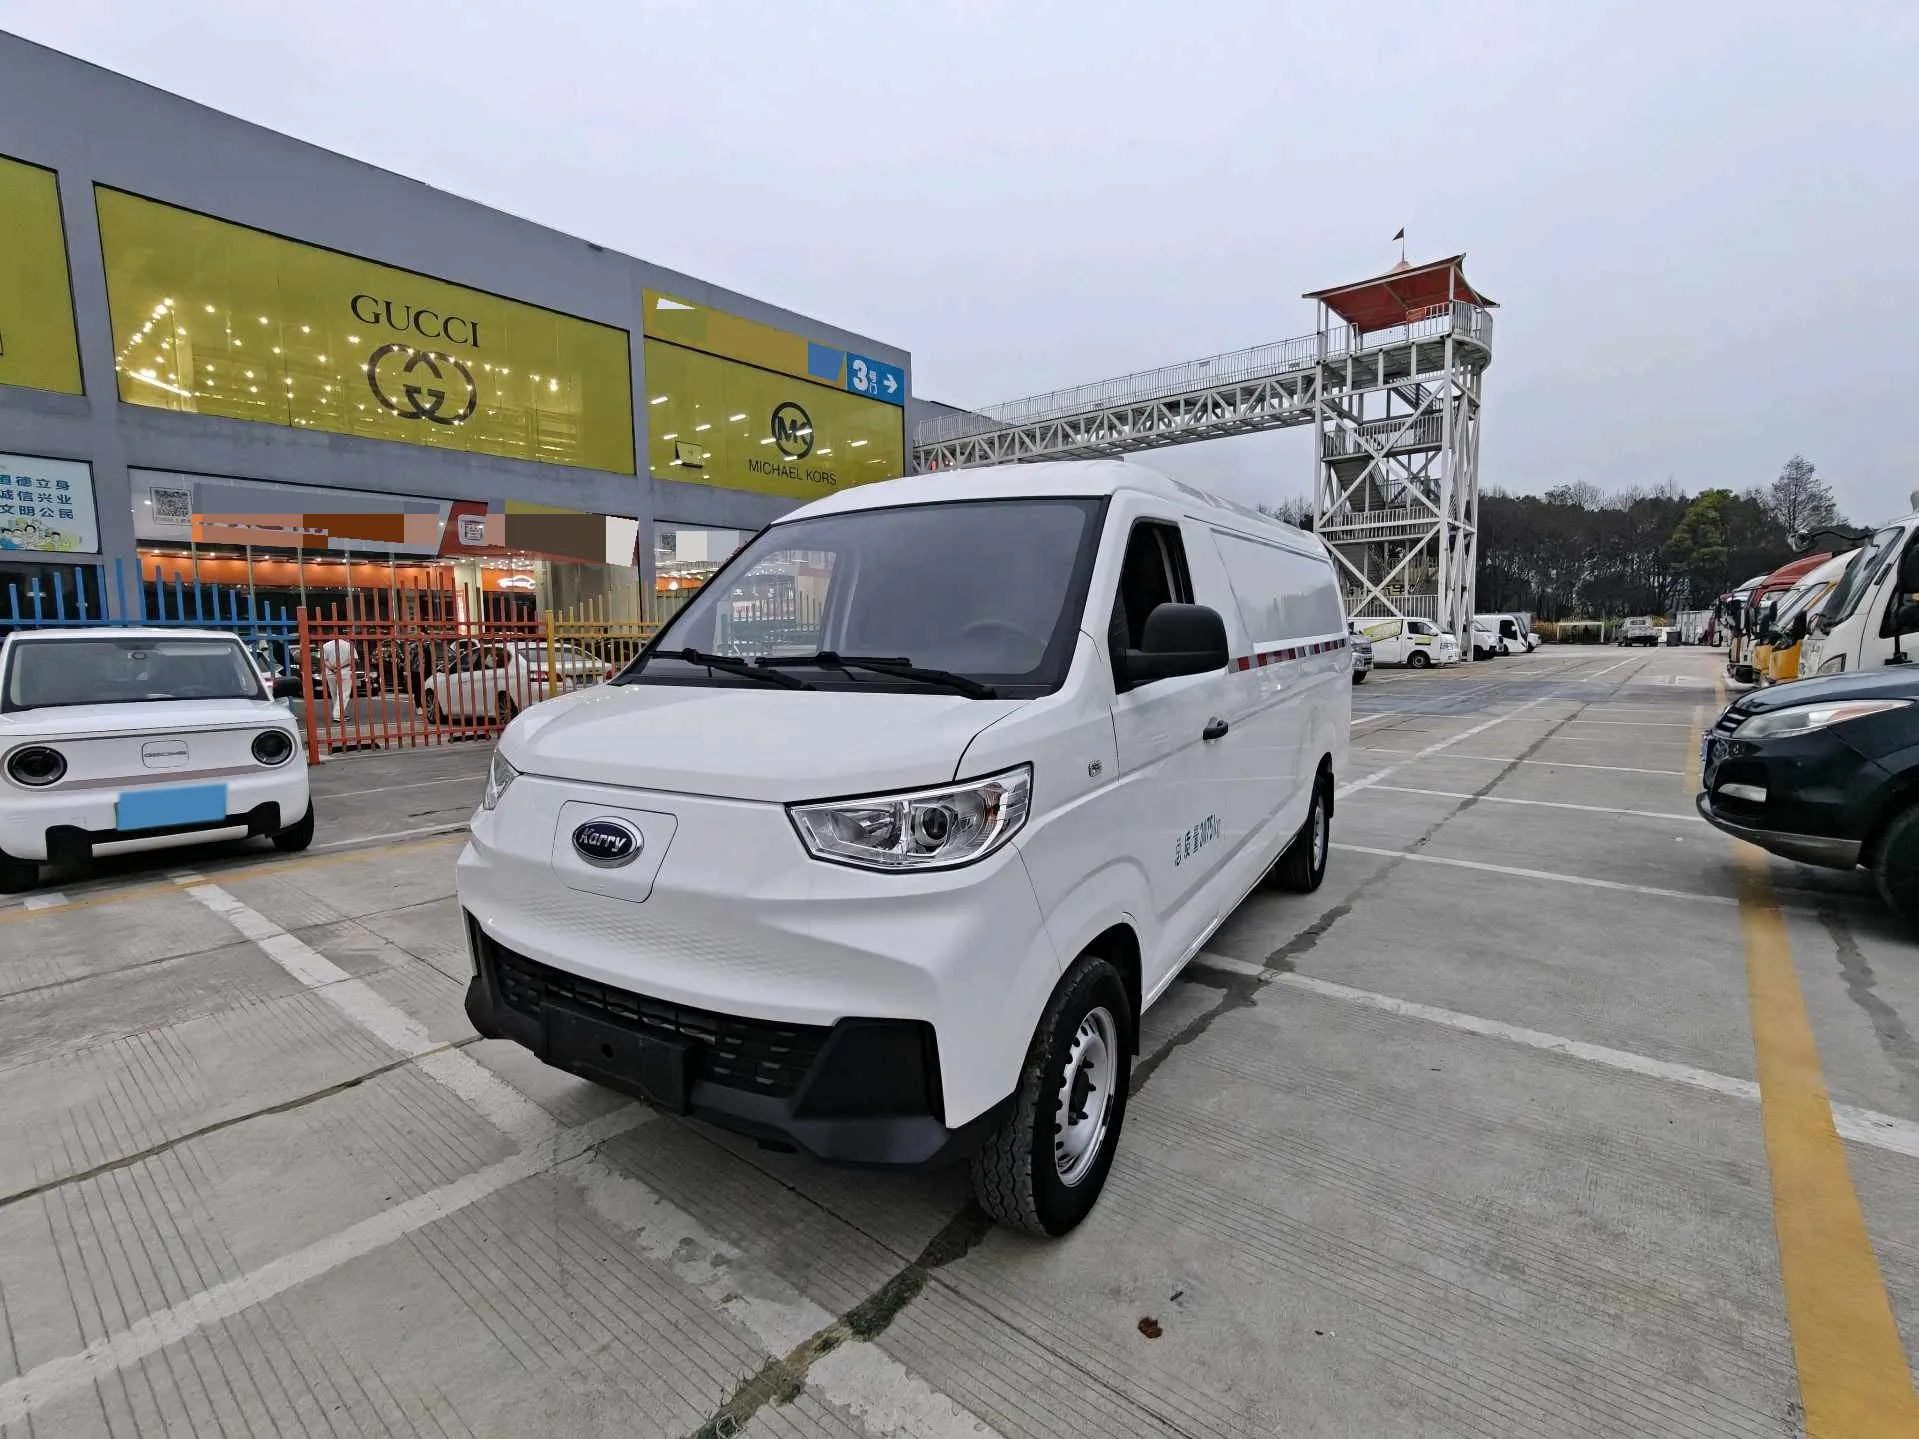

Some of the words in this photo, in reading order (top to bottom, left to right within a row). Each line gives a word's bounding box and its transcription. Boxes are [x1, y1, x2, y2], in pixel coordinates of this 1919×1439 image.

[350, 294, 480, 348] GUCCI
[748, 458, 804, 480] MICHAEL
[806, 469, 837, 486] KORS
[0, 503, 74, 520] 文明公民
